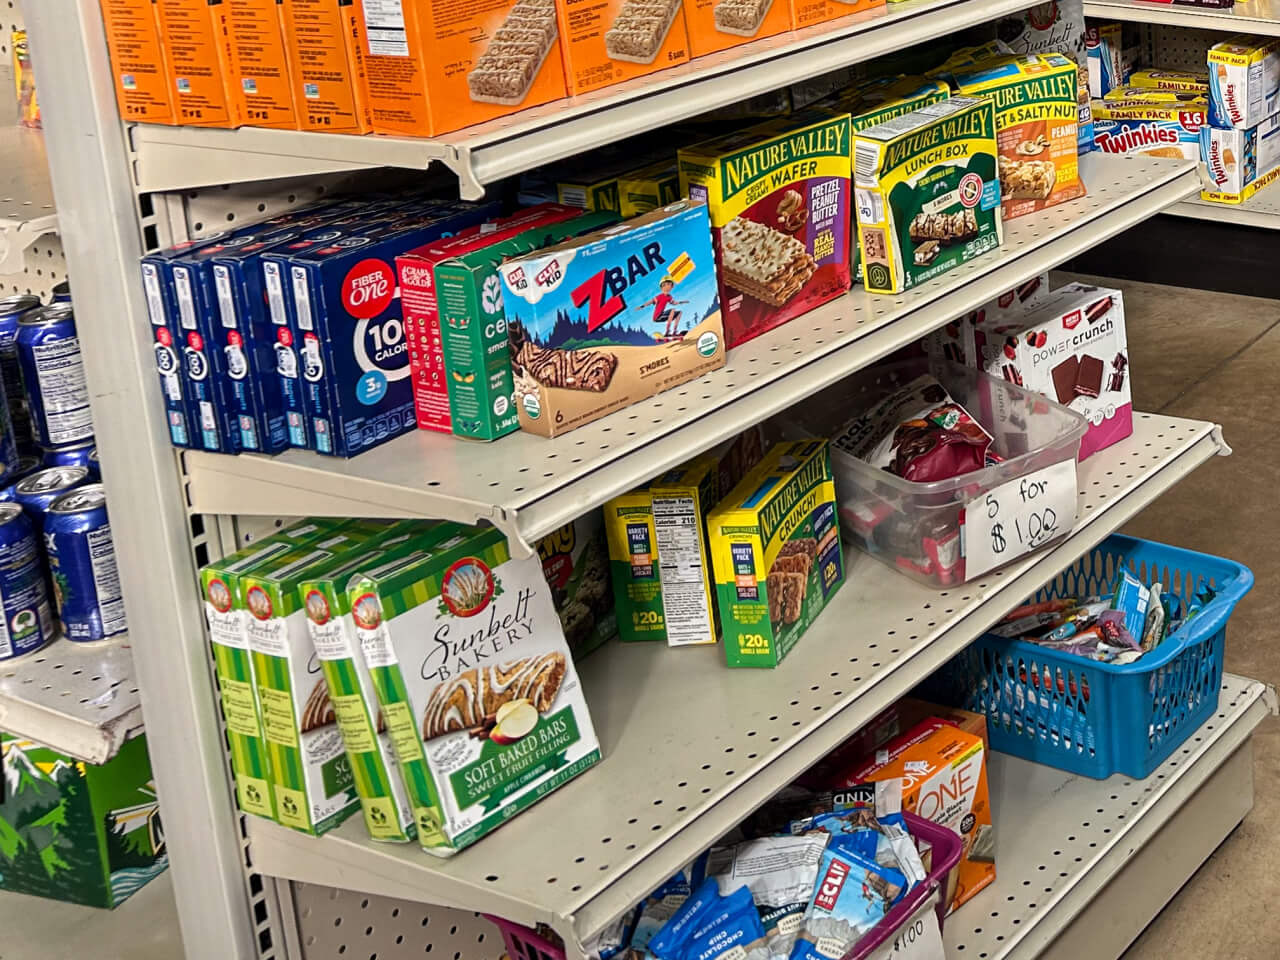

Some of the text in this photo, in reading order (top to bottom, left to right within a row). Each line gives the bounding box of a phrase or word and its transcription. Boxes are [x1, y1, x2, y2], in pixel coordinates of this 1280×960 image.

[1024, 74, 1077, 103] VALLEY
[1225, 83, 1243, 126] Twinkies
[1017, 104, 1077, 121] SALTY NUT
[1110, 110, 1172, 120] FAMILY PACK
[1184, 112, 1202, 125] 16
[881, 107, 992, 175] NATURE VALLEY
[1094, 123, 1179, 154] Twinkies
[725, 122, 844, 196] NATURE VALLEY
[770, 160, 818, 187] WAFER
[904, 142, 969, 177] LUNCH BOX
[1210, 139, 1229, 188] Twinkies
[811, 178, 841, 199] PRETZEL
[811, 189, 840, 212] PEANUT
[811, 205, 839, 225] BUTTER
[351, 270, 385, 289] FIBER
[555, 410, 564, 423] 6
[761, 486, 800, 546] NATURE
[984, 478, 1050, 520] 5 for
[778, 490, 819, 543] CRUNCHY
[990, 521, 1006, 554] $
[420, 587, 537, 680] Sunbelt
[436, 617, 537, 683] BAKERY
[464, 715, 567, 789] SOFT BAKED BARS
[467, 732, 571, 800] SWEET FRUIT FILLING
[833, 791, 875, 807] KIND
[919, 761, 976, 820] ONE
